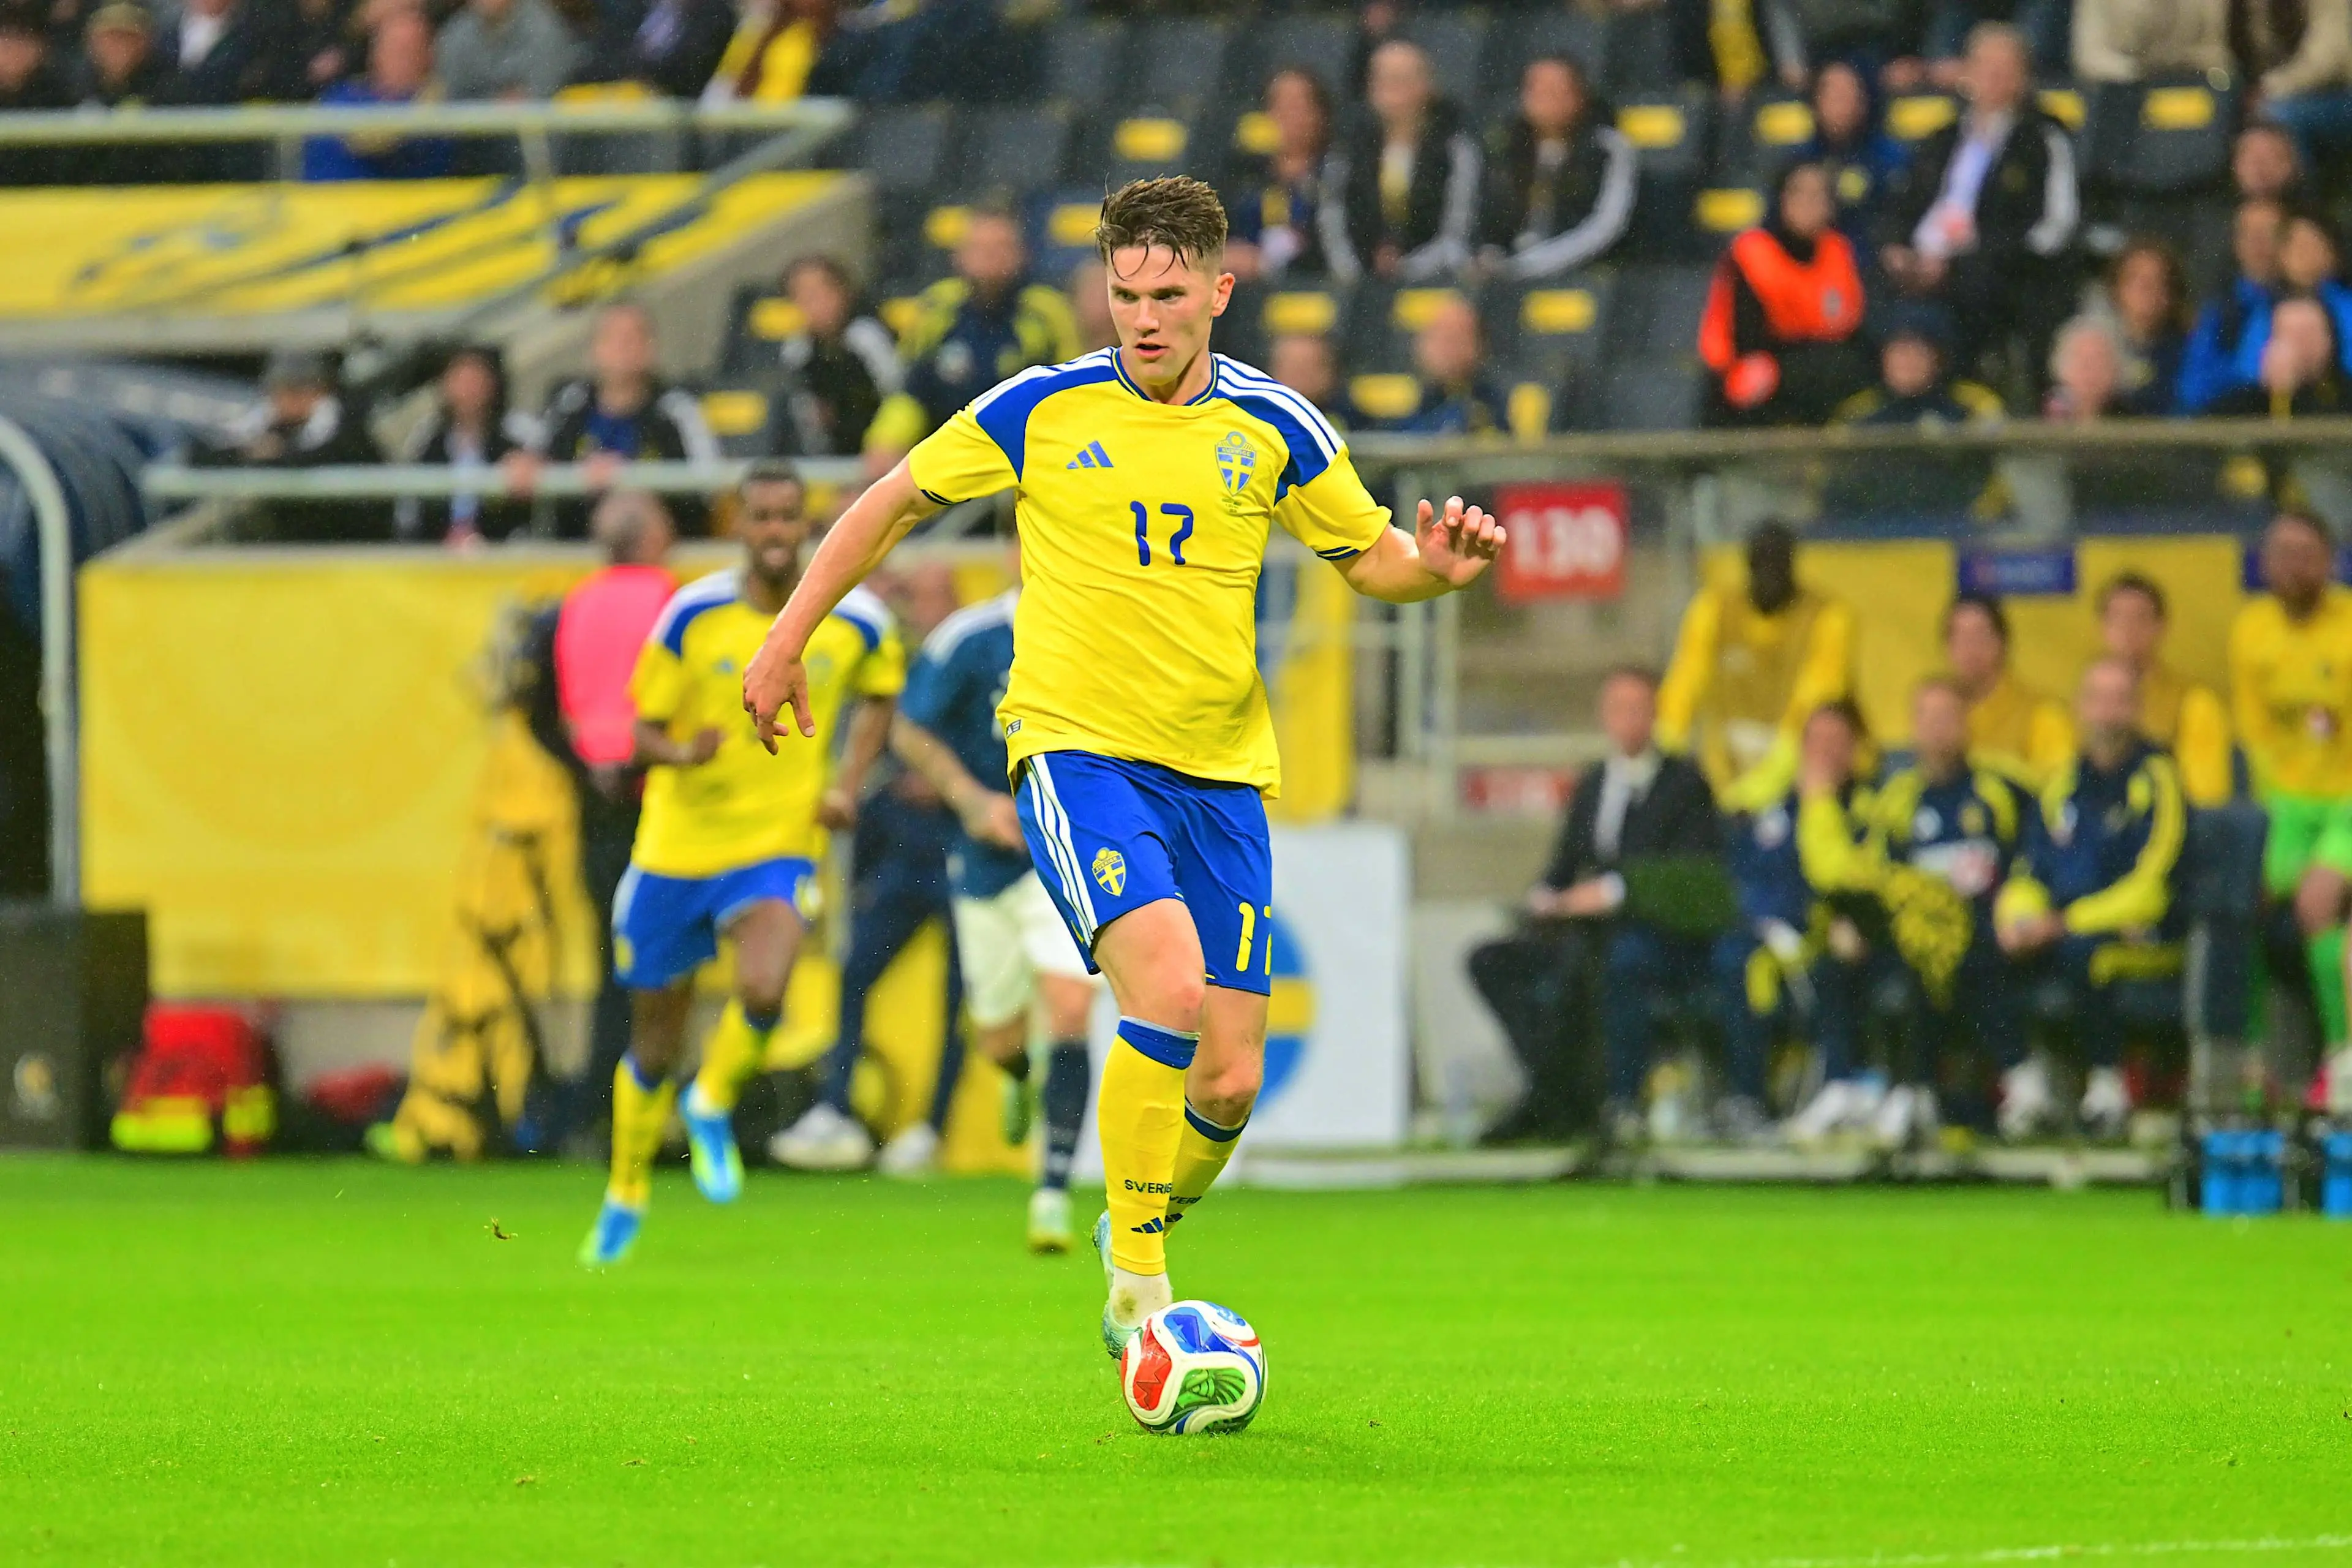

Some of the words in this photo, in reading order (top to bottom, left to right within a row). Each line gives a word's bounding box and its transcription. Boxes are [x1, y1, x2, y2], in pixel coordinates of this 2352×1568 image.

[1130, 500, 1194, 565] 17
[1235, 902, 1272, 976] 1
[1125, 1179, 1172, 1194] SVERIG
